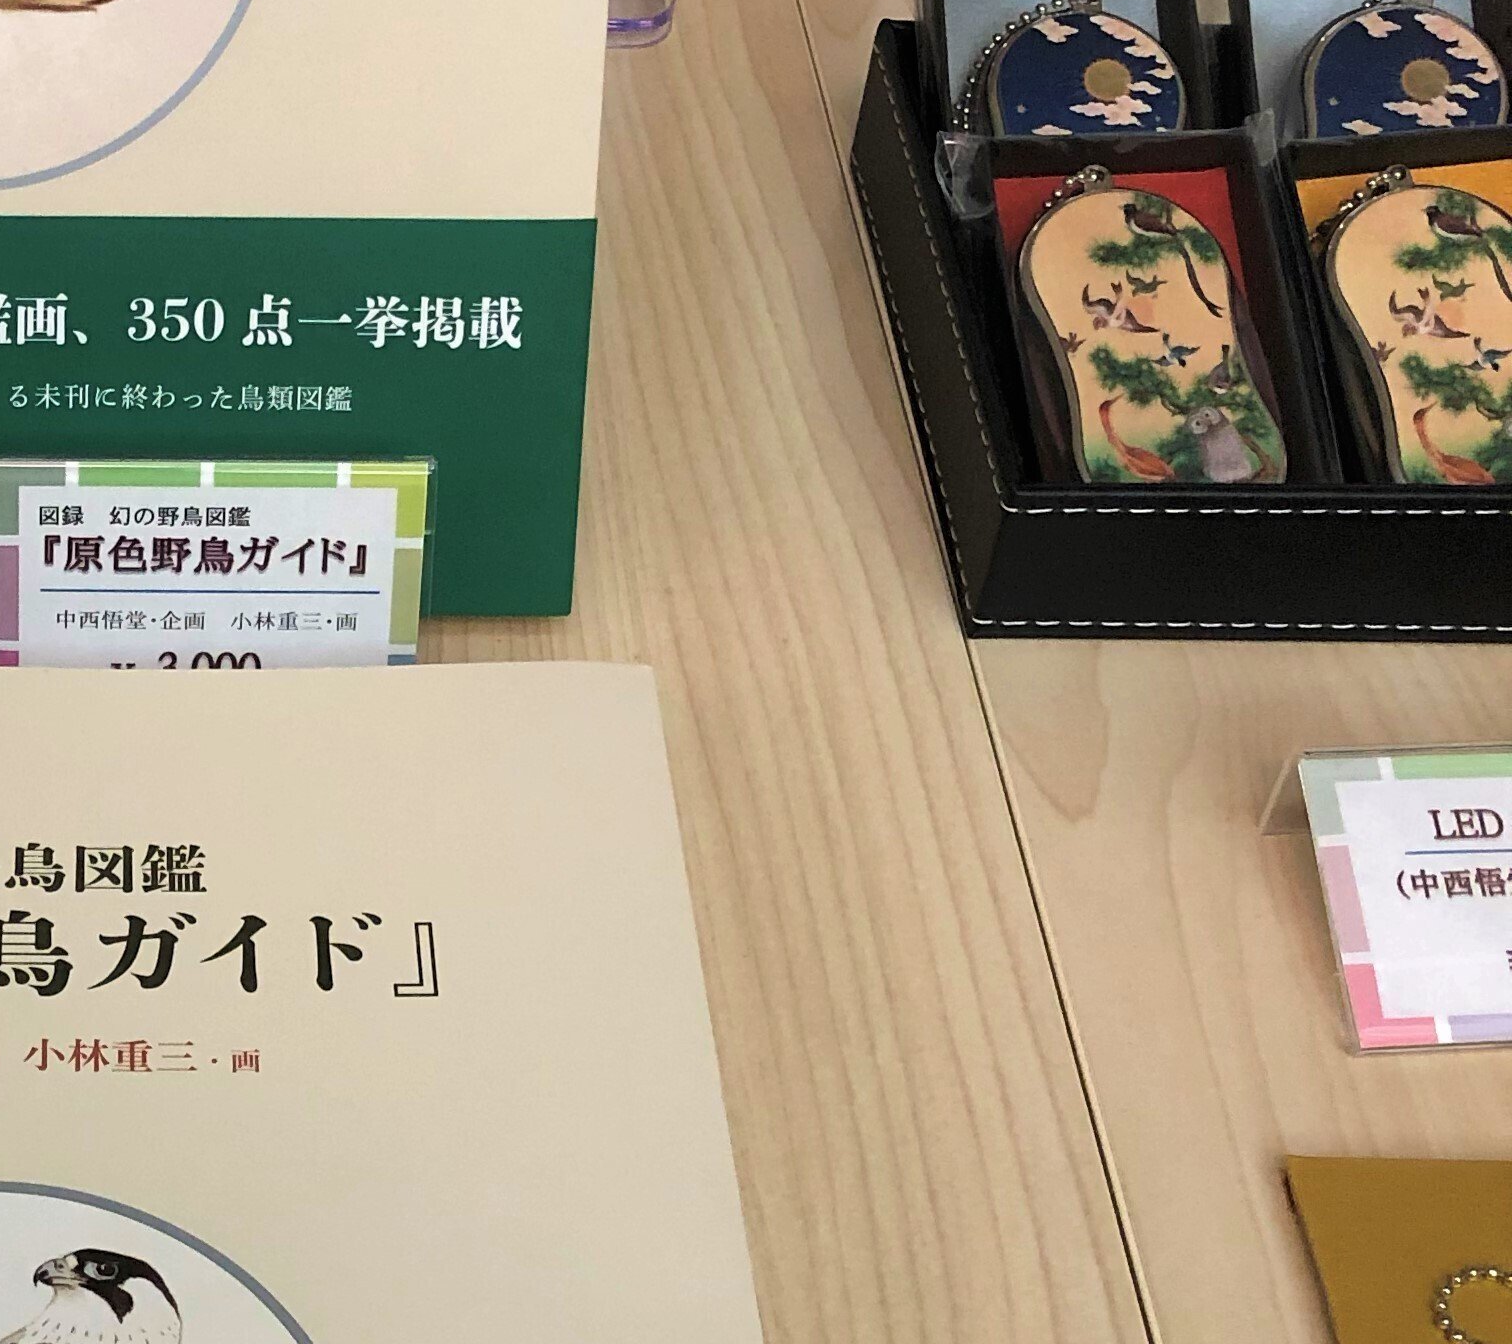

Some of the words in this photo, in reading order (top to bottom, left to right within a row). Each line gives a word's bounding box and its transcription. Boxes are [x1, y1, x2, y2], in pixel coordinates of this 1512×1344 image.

[38, 504, 85, 527] 図録
[108, 505, 252, 528] 幻の野鳥図鑑
[43, 533, 368, 577] 『原色野鳥ガイド』
[55, 608, 206, 632] 中西悟堂・企画
[230, 610, 358, 633] 小林重三・画
[1426, 807, 1505, 842] LED
[1395, 866, 1512, 901] (中西悟
[22, 1037, 261, 1074] 小林重三・画
